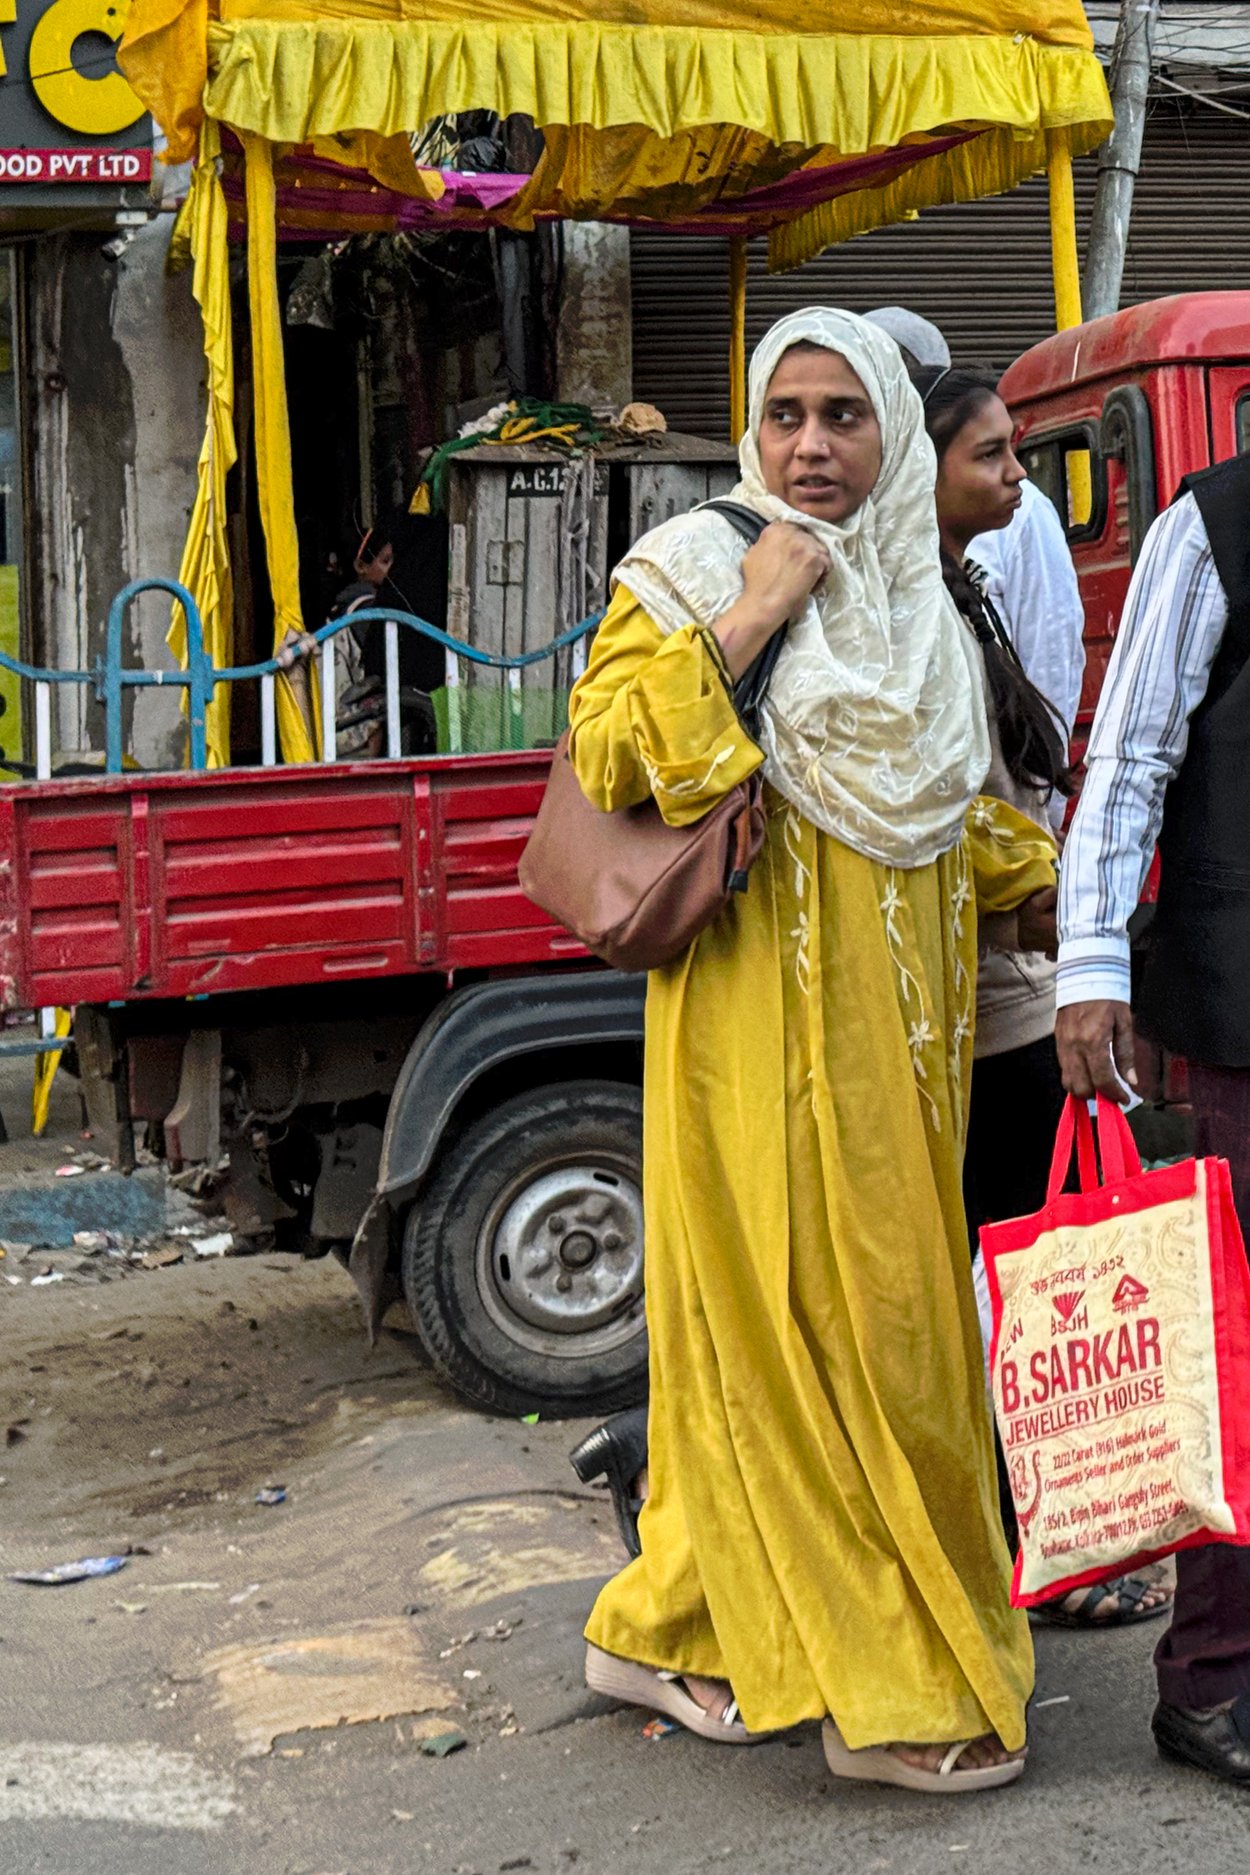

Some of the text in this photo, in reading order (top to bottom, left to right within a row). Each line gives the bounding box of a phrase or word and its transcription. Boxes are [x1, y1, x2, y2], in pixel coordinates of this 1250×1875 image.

[49, 155, 93, 177] PVT
[98, 154, 140, 177] LTD
[1001, 1317, 1163, 1414] B.SARKAR
[1006, 1375, 1165, 1446] JEWELLERY HOUSE
